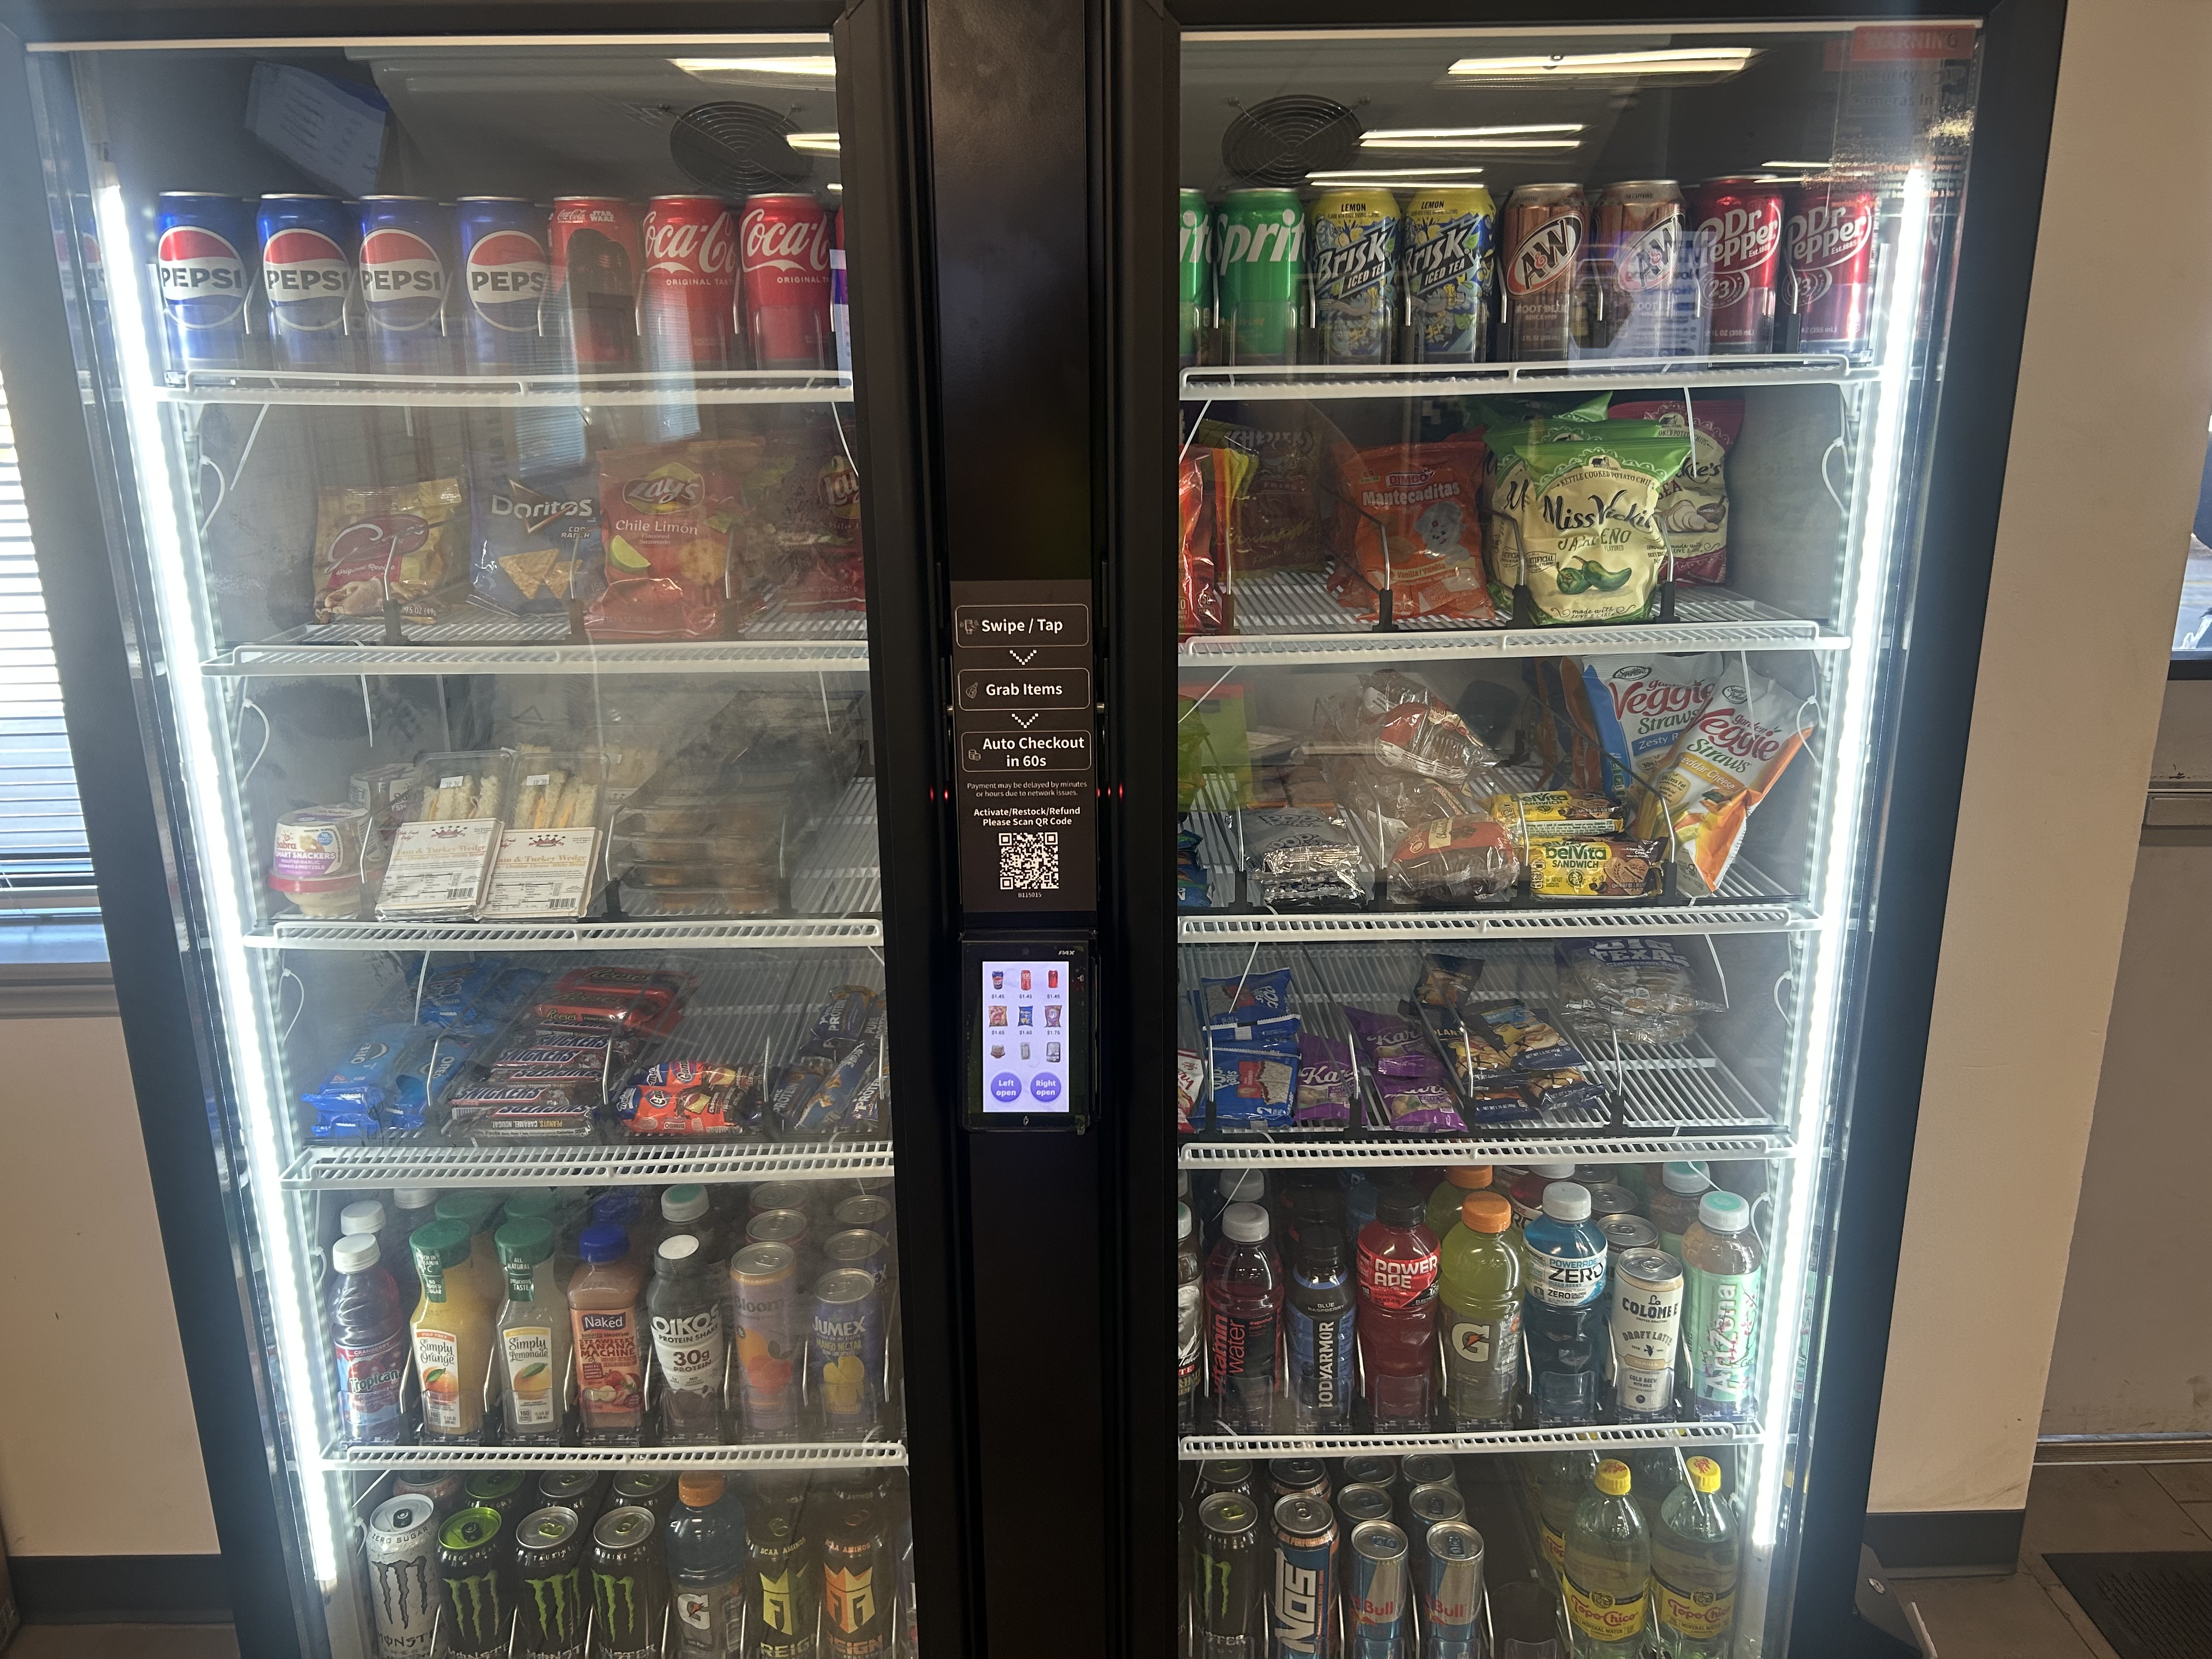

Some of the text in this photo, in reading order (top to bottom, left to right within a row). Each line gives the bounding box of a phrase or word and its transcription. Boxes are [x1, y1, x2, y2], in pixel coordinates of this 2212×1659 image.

[1341, 203, 1365, 212] LEMON
[1421, 200, 1444, 209] LEMON
[1725, 208, 1762, 244] Dr
[1808, 206, 1847, 237] Dr
[643, 211, 737, 273] Coca-Co
[741, 208, 829, 272] Coca-C
[1216, 210, 1306, 275] Sprit
[1694, 217, 1779, 268] Pepper
[1785, 215, 1867, 264] Pepper
[1521, 219, 1570, 290] A&W
[1636, 216, 1679, 287] A&W
[161, 267, 241, 289] PEPSI
[267, 270, 349, 290] PEPSI
[362, 270, 440, 290] PEPSI
[1347, 261, 1386, 289] ICED TEA
[1425, 259, 1465, 286] ICED TEA
[471, 271, 547, 292] PEPS
[1710, 279, 1729, 298] 23
[1560, 471, 1635, 487] KETTLE COOKED POTATO
[628, 478, 699, 504] Lay's
[1362, 482, 1460, 506] Mantecaditas
[492, 494, 593, 518] Doritos
[1544, 495, 1595, 531] Miss
[616, 520, 698, 534] Chile Limón
[982, 618, 1063, 635] Swipe / Tap
[986, 683, 1063, 696] Grab Items
[1638, 709, 1699, 735] Straws
[1685, 697, 1779, 761] Veggie
[983, 737, 1085, 750] Auto Checkout
[1639, 736, 1668, 751] Zesty
[1007, 755, 1047, 767] in 60s
[1686, 739, 1750, 773] Straws
[1707, 770, 1735, 789] Cheese
[974, 806, 1080, 816] Activate/Restock/Refund
[1035, 818, 1048, 826] QR
[276, 837, 297, 849] Sabra
[1546, 844, 1606, 860] belVita
[1552, 860, 1599, 869] SANDWICH
[1589, 949, 1690, 967] TEXAS
[547, 1009, 579, 1021] Reese's
[828, 1000, 847, 1031] PROTEIN
[499, 1049, 577, 1063] SNICKERS
[1036, 1079, 1056, 1087] Right
[457, 1088, 542, 1101] SNICKERS
[773, 1083, 799, 1113] PROTEIN
[1375, 1255, 1438, 1274] POWER
[1550, 1258, 1598, 1268] POWERADE
[1548, 1262, 1603, 1283] ZERO
[1374, 1274, 1412, 1289] ADE
[1548, 1289, 1570, 1299] ZERO
[1648, 1295, 1661, 1306] La
[1308, 1304, 1344, 1312] RASPBERRY
[1622, 1297, 1679, 1319] COLOME
[584, 1317, 623, 1328] Naked
[812, 1315, 866, 1336] JUMEX
[509, 1336, 547, 1351] Simply
[659, 1334, 693, 1344] PROTEIN
[838, 1340, 862, 1351] NECTAR
[1229, 1319, 1245, 1373] water
[1452, 1323, 1490, 1362] G
[1622, 1330, 1672, 1346] DRAFT LATTE
[1705, 1283, 1738, 1395] AriZona
[354, 1341, 390, 1356] CRANBERRY
[420, 1339, 453, 1356] Simply
[580, 1348, 636, 1357] MACHINE
[420, 1352, 454, 1364] Orange
[509, 1351, 549, 1362] Lemonade
[673, 1350, 710, 1367] 30g
[674, 1359, 712, 1372] PROTEIN
[371, 1526, 430, 1545] ZERO SUGAR
[782, 1537, 806, 1554] AMINOS
[843, 1542, 871, 1553] AMINOS
[1274, 1547, 1316, 1654] NOS
[1364, 1600, 1394, 1616] Bull
[1434, 1600, 1464, 1617] Bull
[1668, 1598, 1702, 1620] Topo
[678, 1593, 710, 1630] G
[1571, 1594, 1638, 1627] Topo Chico
